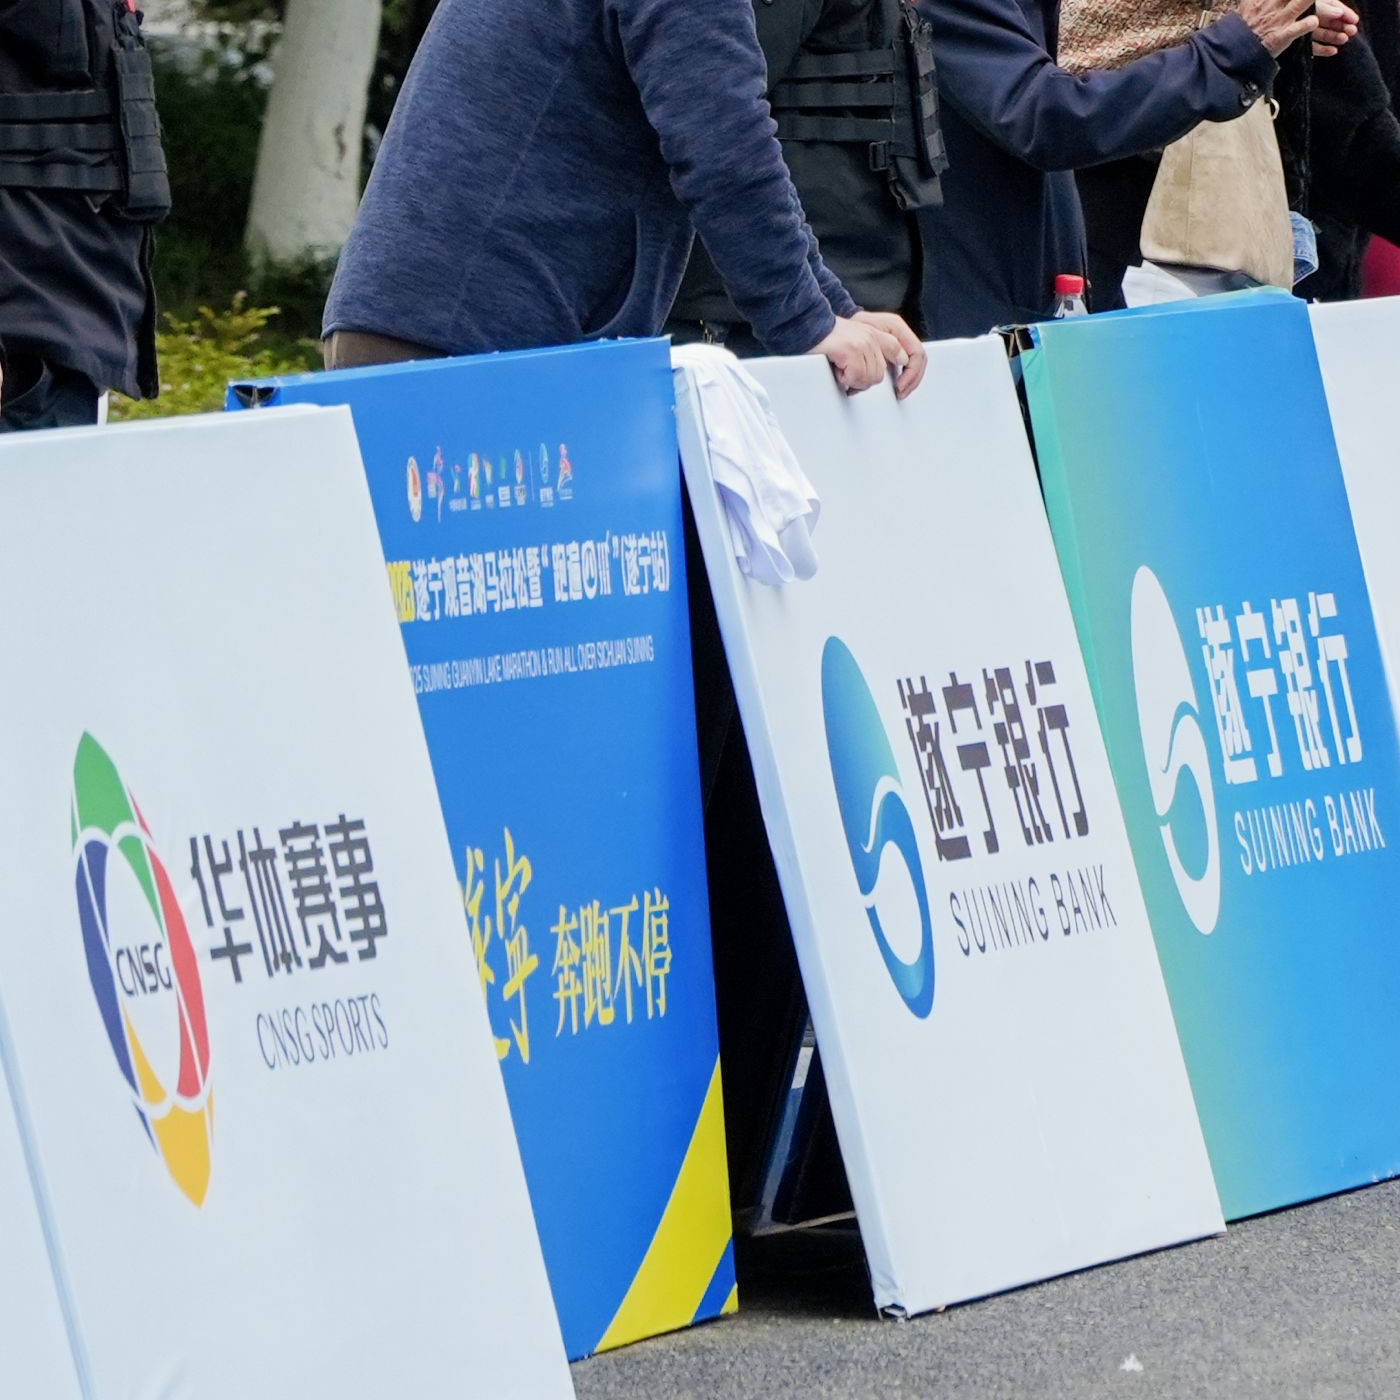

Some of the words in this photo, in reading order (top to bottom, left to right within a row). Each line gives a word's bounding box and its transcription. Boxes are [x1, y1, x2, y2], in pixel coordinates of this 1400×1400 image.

[1196, 592, 1363, 785] 遂宁银行
[896, 659, 1090, 863] 遂宁银行
[1233, 803, 1324, 876] SUINING
[1324, 787, 1385, 858] BANK
[190, 813, 389, 984] 华体赛事
[949, 873, 1047, 957] SUINING
[1048, 864, 1118, 938] BANK
[115, 940, 174, 998] CNSG
[549, 887, 672, 1038] 奔跑不停
[256, 1004, 318, 1070] CNSG
[313, 993, 389, 1062] SPORTS
